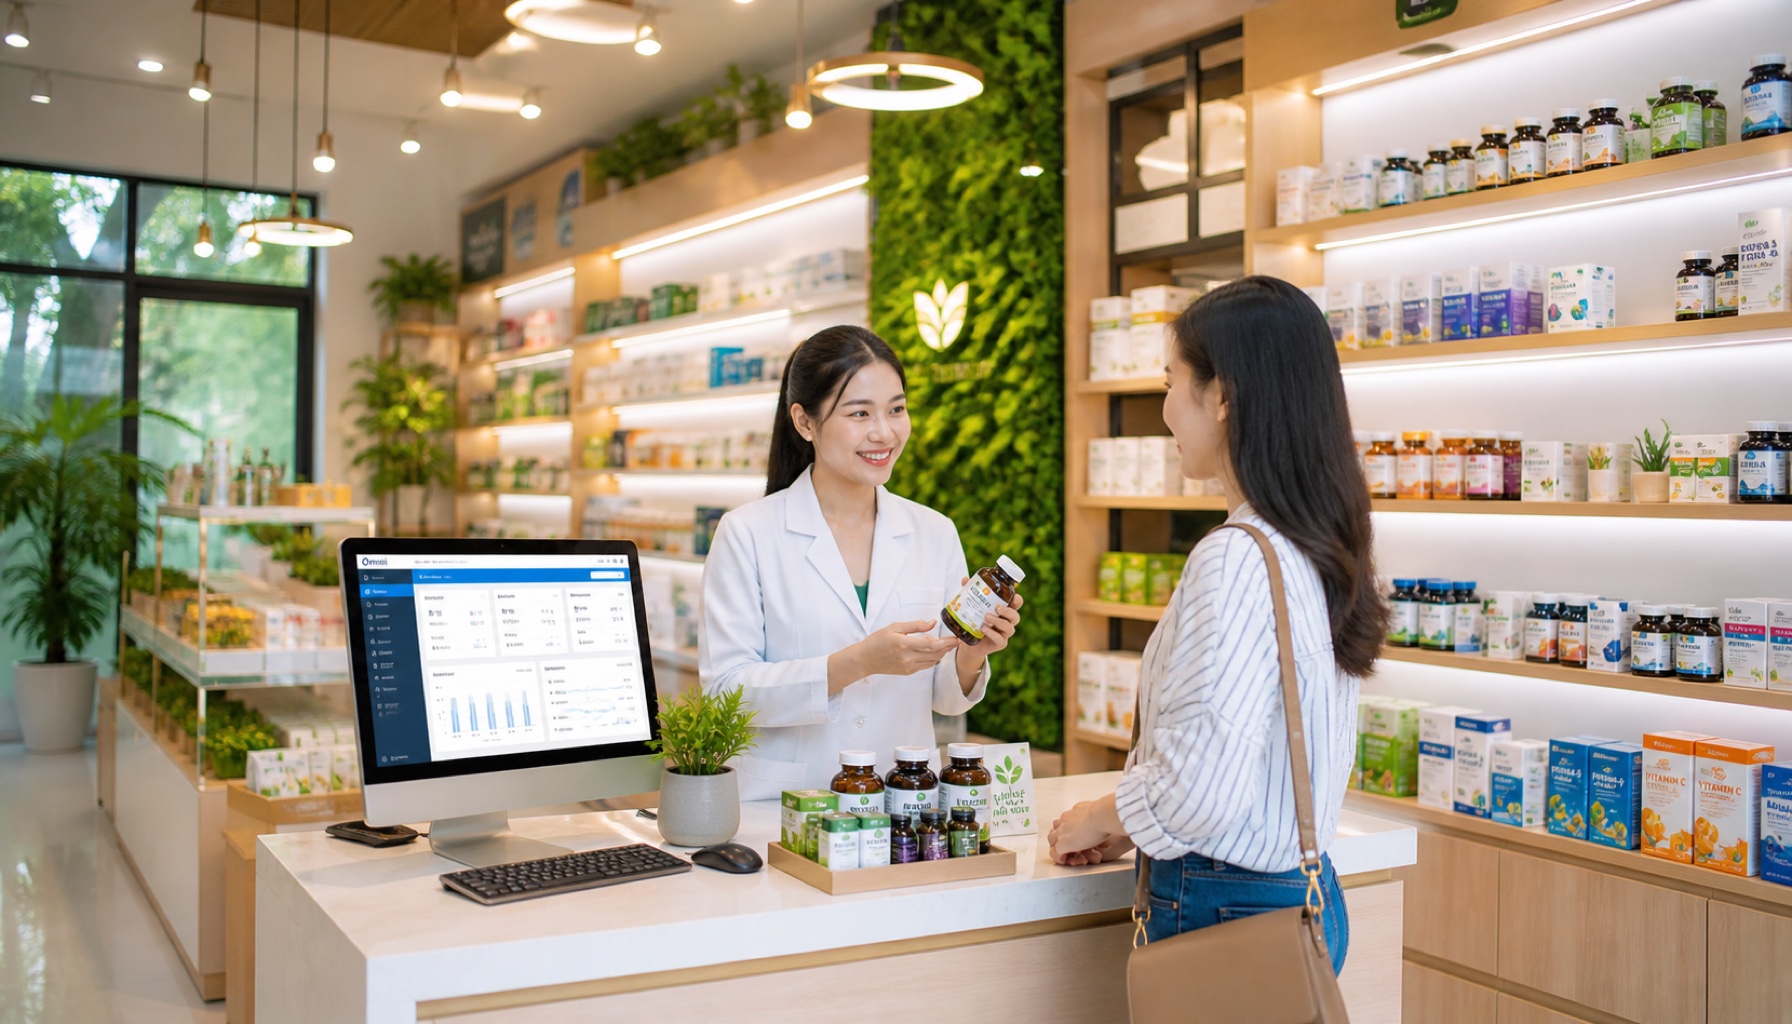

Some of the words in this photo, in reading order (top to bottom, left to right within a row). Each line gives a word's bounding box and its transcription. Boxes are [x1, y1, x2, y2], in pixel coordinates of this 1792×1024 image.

[1646, 771, 1679, 785] VITAMIN
[1680, 778, 1687, 787] C
[1698, 780, 1734, 795] VITAMIN
[1735, 787, 1742, 796] C
